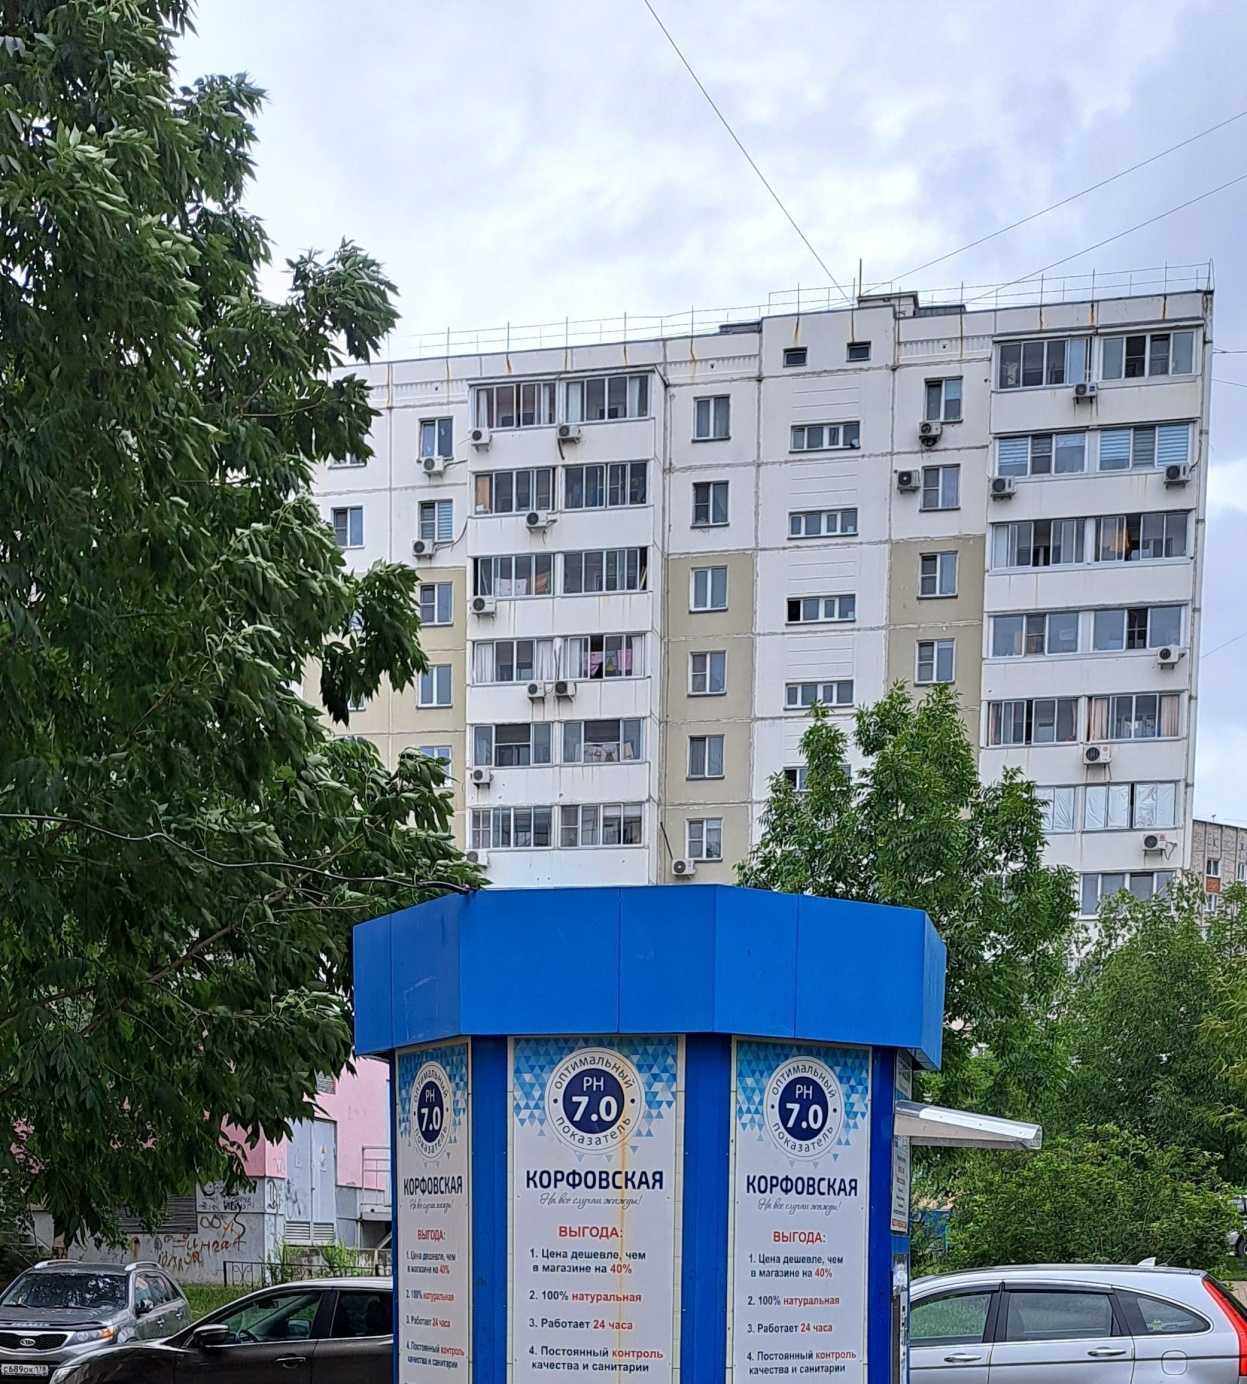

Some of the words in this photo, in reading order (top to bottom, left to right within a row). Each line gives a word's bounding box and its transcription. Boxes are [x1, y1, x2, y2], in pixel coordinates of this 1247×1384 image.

[555, 1056, 635, 1089] оптимальный
[773, 1064, 836, 1098] оптимальный
[572, 1096, 617, 1121] 7.0
[421, 1107, 441, 1132] 7.0
[786, 1103, 823, 1130] 7.0
[556, 1116, 630, 1146] показатель
[773, 1122, 834, 1153] показатель
[404, 1176, 463, 1196] КОРФОВСКАЯ
[526, 1170, 663, 1190] КОРФОВСКАЯ
[747, 1175, 858, 1197] КОРФОВСКАЯ
[418, 1230, 446, 1242] ВЫГОДА:
[559, 1226, 623, 1239] ВЫГОДА:
[773, 1232, 826, 1245] ВЫГОДА:
[530, 1249, 538, 1259] 1.
[542, 1249, 568, 1261] Цена
[571, 1251, 622, 1261] дешевле,
[625, 1252, 646, 1260] чем
[749, 1254, 756, 1264] 1.
[759, 1254, 781, 1265] Цена
[783, 1256, 825, 1265] дешевле,
[828, 1256, 843, 1264] чем
[542, 1265, 592, 1273] магазине
[610, 1264, 632, 1274] 40%
[815, 1268, 832, 1278] 40%
[529, 1291, 538, 1300] 2.
[542, 1291, 569, 1301] 100%
[572, 1293, 641, 1303] натуральная
[748, 1296, 755, 1305] 2.
[759, 1296, 781, 1305] 100%
[784, 1297, 840, 1307] натуральная
[529, 1318, 538, 1328] 3.
[541, 1319, 590, 1329] Работает
[593, 1320, 605, 1329] 24
[608, 1322, 633, 1330] часа
[747, 1324, 755, 1333] 3.
[758, 1324, 798, 1333] Работает
[800, 1323, 811, 1333] 24
[813, 1324, 832, 1332] часа
[529, 1346, 537, 1355] 4.
[541, 1346, 608, 1357] Постоянный
[612, 1350, 663, 1360] контроль
[747, 1352, 754, 1361] 4.
[758, 1351, 813, 1361] Постоянный
[815, 1352, 856, 1361] контроль
[592, 1363, 649, 1373] санитарии
[749, 1366, 789, 1375] качества
[792, 1366, 797, 1374] и
[800, 1366, 845, 1375] санитарии
